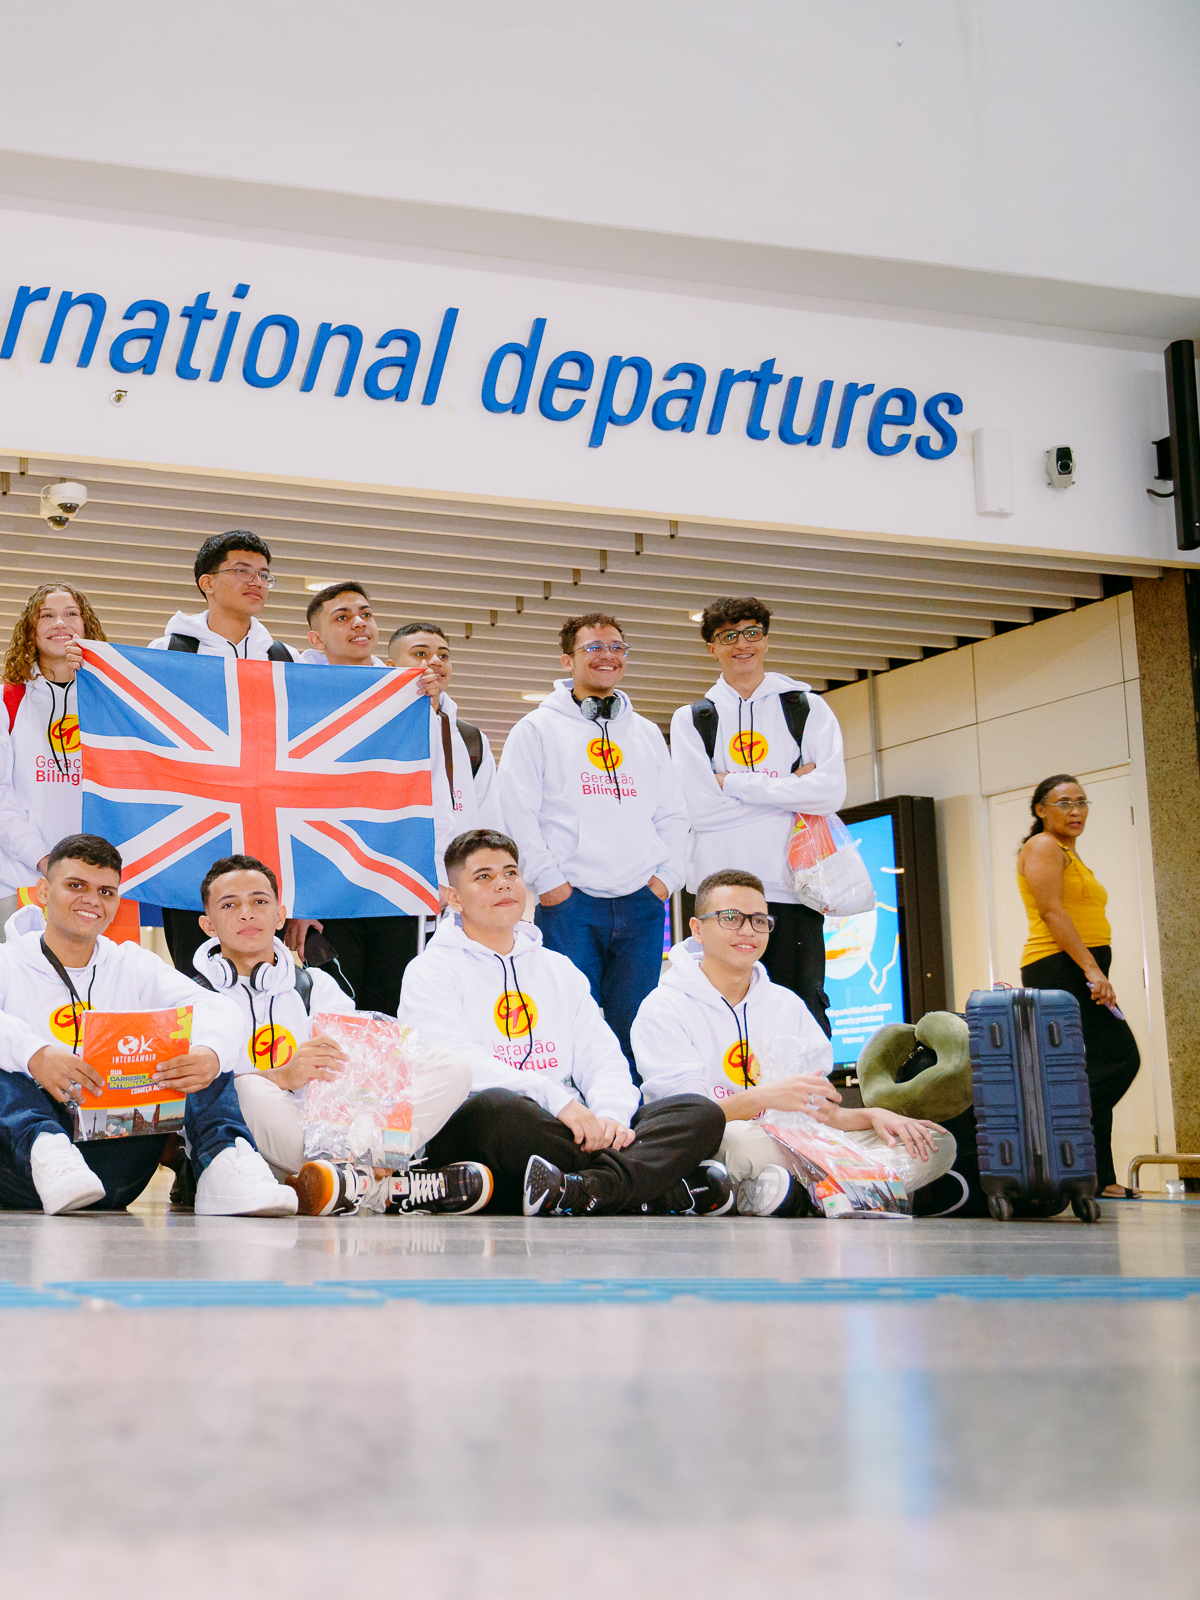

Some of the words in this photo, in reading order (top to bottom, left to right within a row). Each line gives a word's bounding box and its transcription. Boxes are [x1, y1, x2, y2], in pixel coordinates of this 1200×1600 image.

[481, 317, 964, 461] departures
[35, 755, 82, 773] Geraç
[36, 769, 83, 786] Bilíng
[580, 771, 635, 785] Geração
[582, 783, 637, 799] Bilíngue
